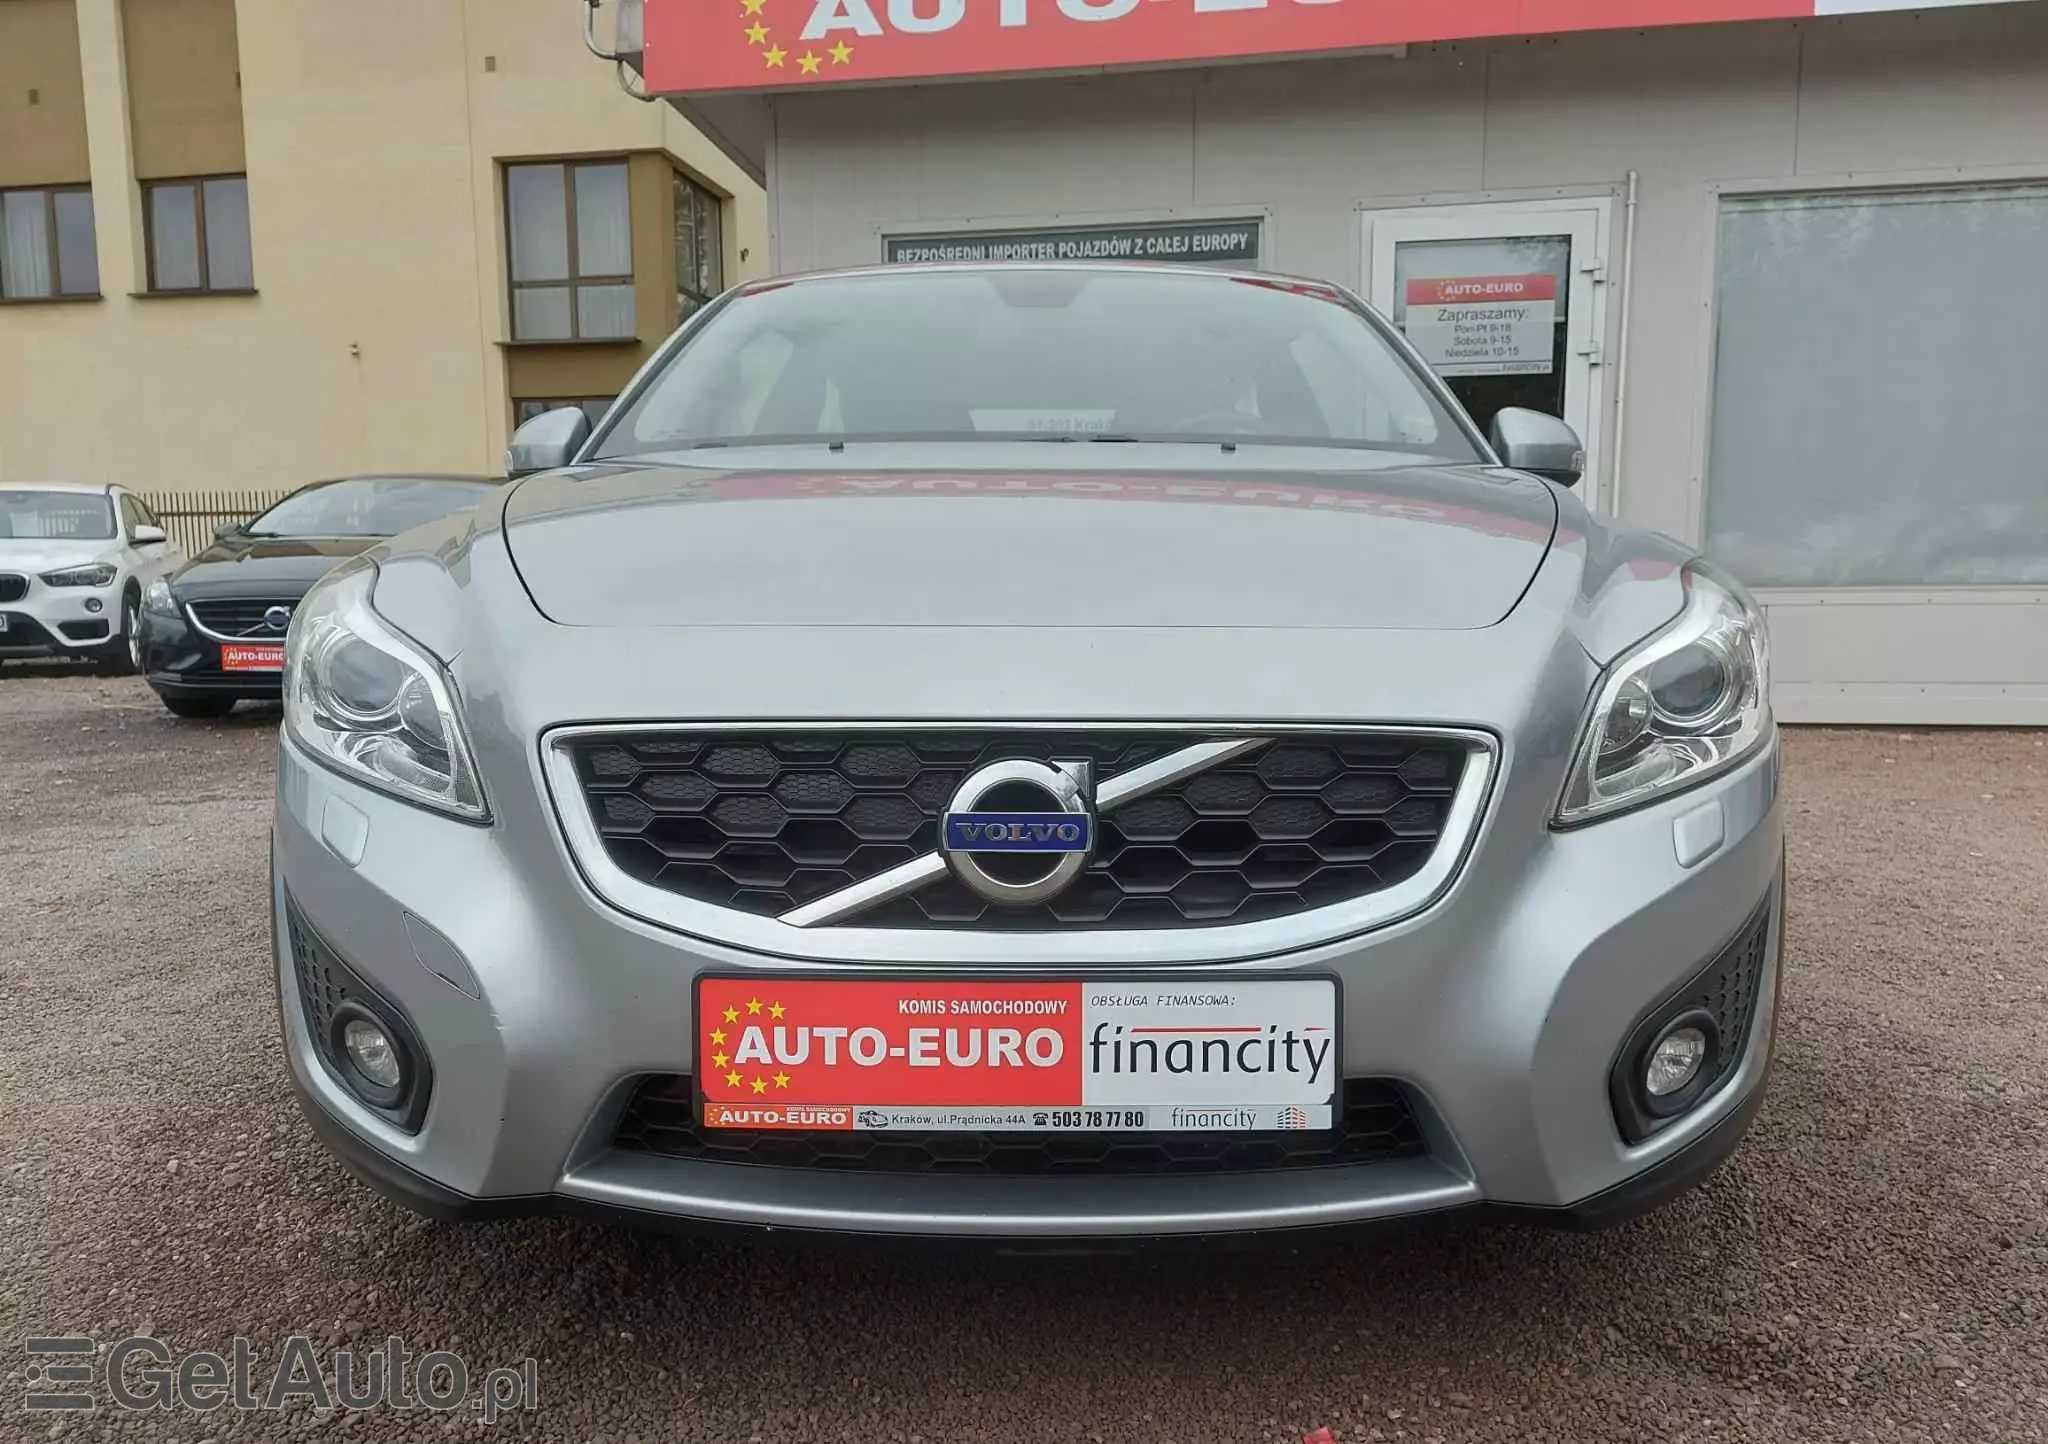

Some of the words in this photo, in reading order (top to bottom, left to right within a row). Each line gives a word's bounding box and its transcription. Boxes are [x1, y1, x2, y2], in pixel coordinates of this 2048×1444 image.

[989, 242, 1055, 261] IMPORTER
[1058, 236, 1131, 258] POJAZDÓW
[1134, 238, 1143, 254] Z
[1147, 234, 1189, 253] CAŁEJ
[1193, 232, 1248, 251] EUROPY
[1445, 282, 1523, 295] AUTO-EURO
[956, 822, 1080, 842] VOLVO
[899, 999, 946, 1015] KOMIS
[950, 1000, 1068, 1015] SAMOCHODOWY
[1091, 995, 1148, 1007] OBSŁUGA
[1156, 995, 1236, 1007] FINANSOWA:
[734, 1026, 1063, 1066] AUTO-EURO
[1089, 1022, 1331, 1084] financity
[719, 1110, 847, 1125] AUTO-EURO
[891, 1114, 934, 1126] Kraków,
[1006, 1115, 1026, 1125] 44A
[1171, 1107, 1257, 1130] financity
